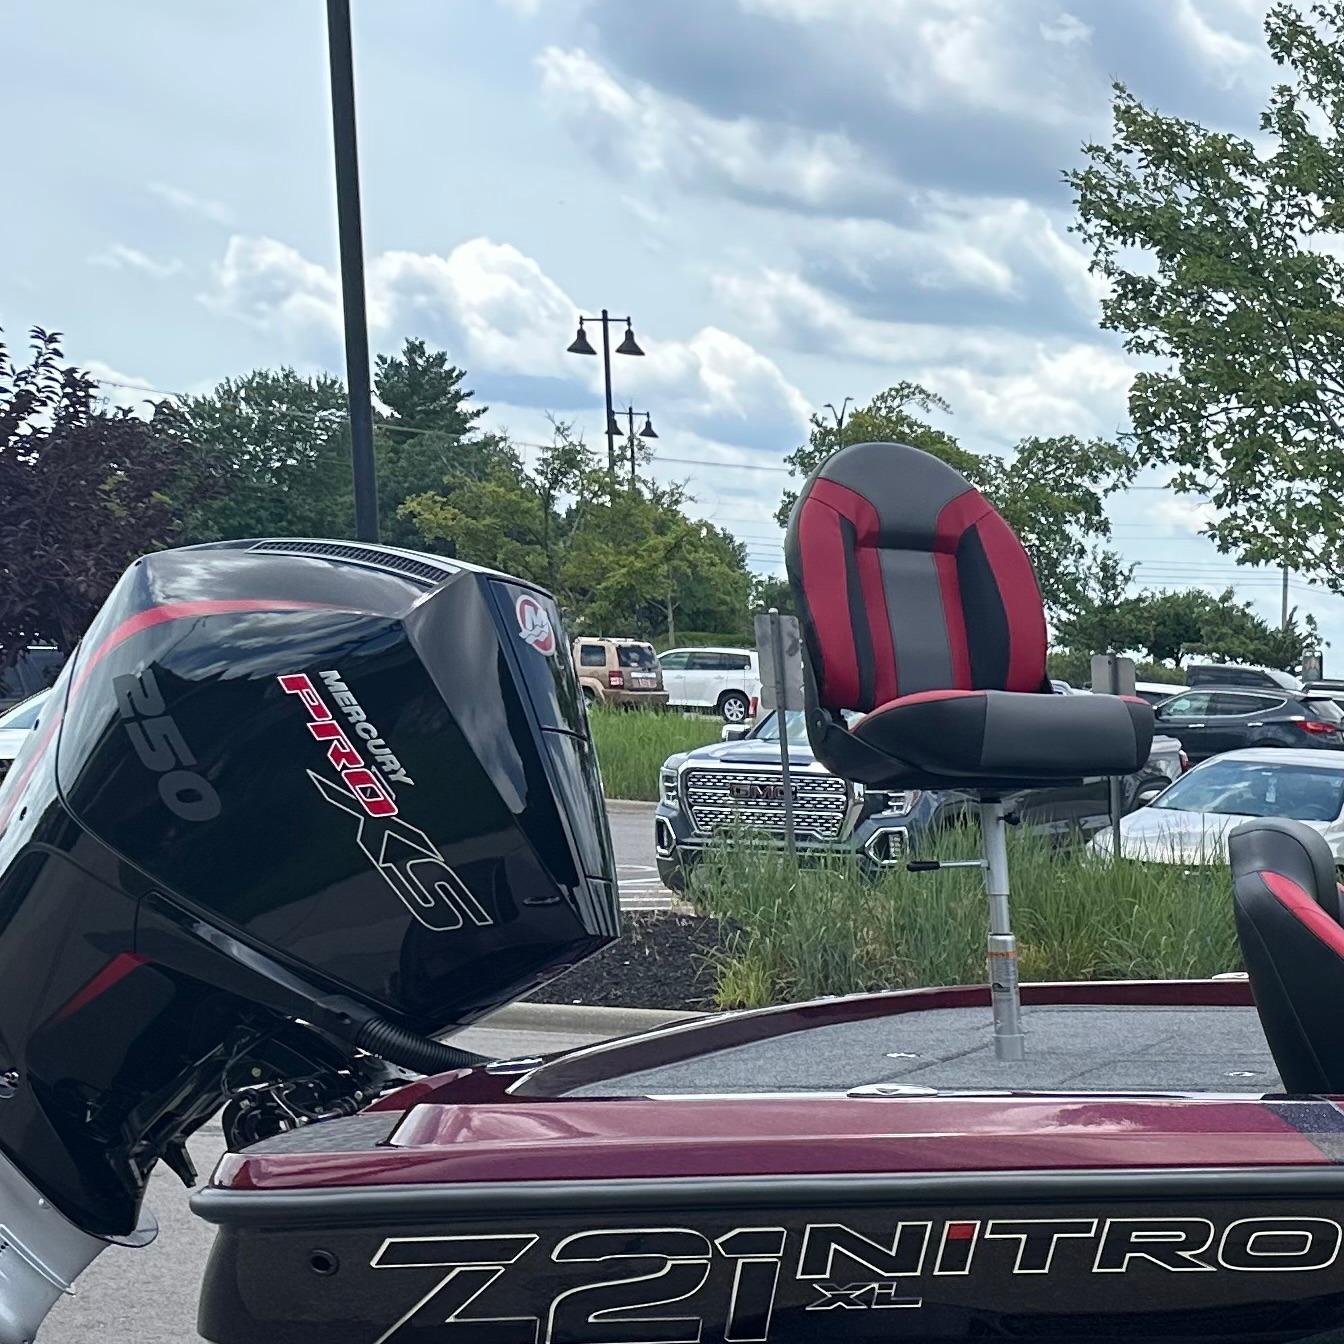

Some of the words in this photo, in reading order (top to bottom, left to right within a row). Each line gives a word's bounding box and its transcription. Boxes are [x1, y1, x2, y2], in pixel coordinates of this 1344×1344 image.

[113, 666, 222, 823] 250
[276, 672, 399, 818] PRO
[318, 669, 415, 787] MERCURY
[306, 768, 495, 932] XS
[796, 1216, 1343, 1280] NITRO
[805, 1281, 922, 1311] XL
